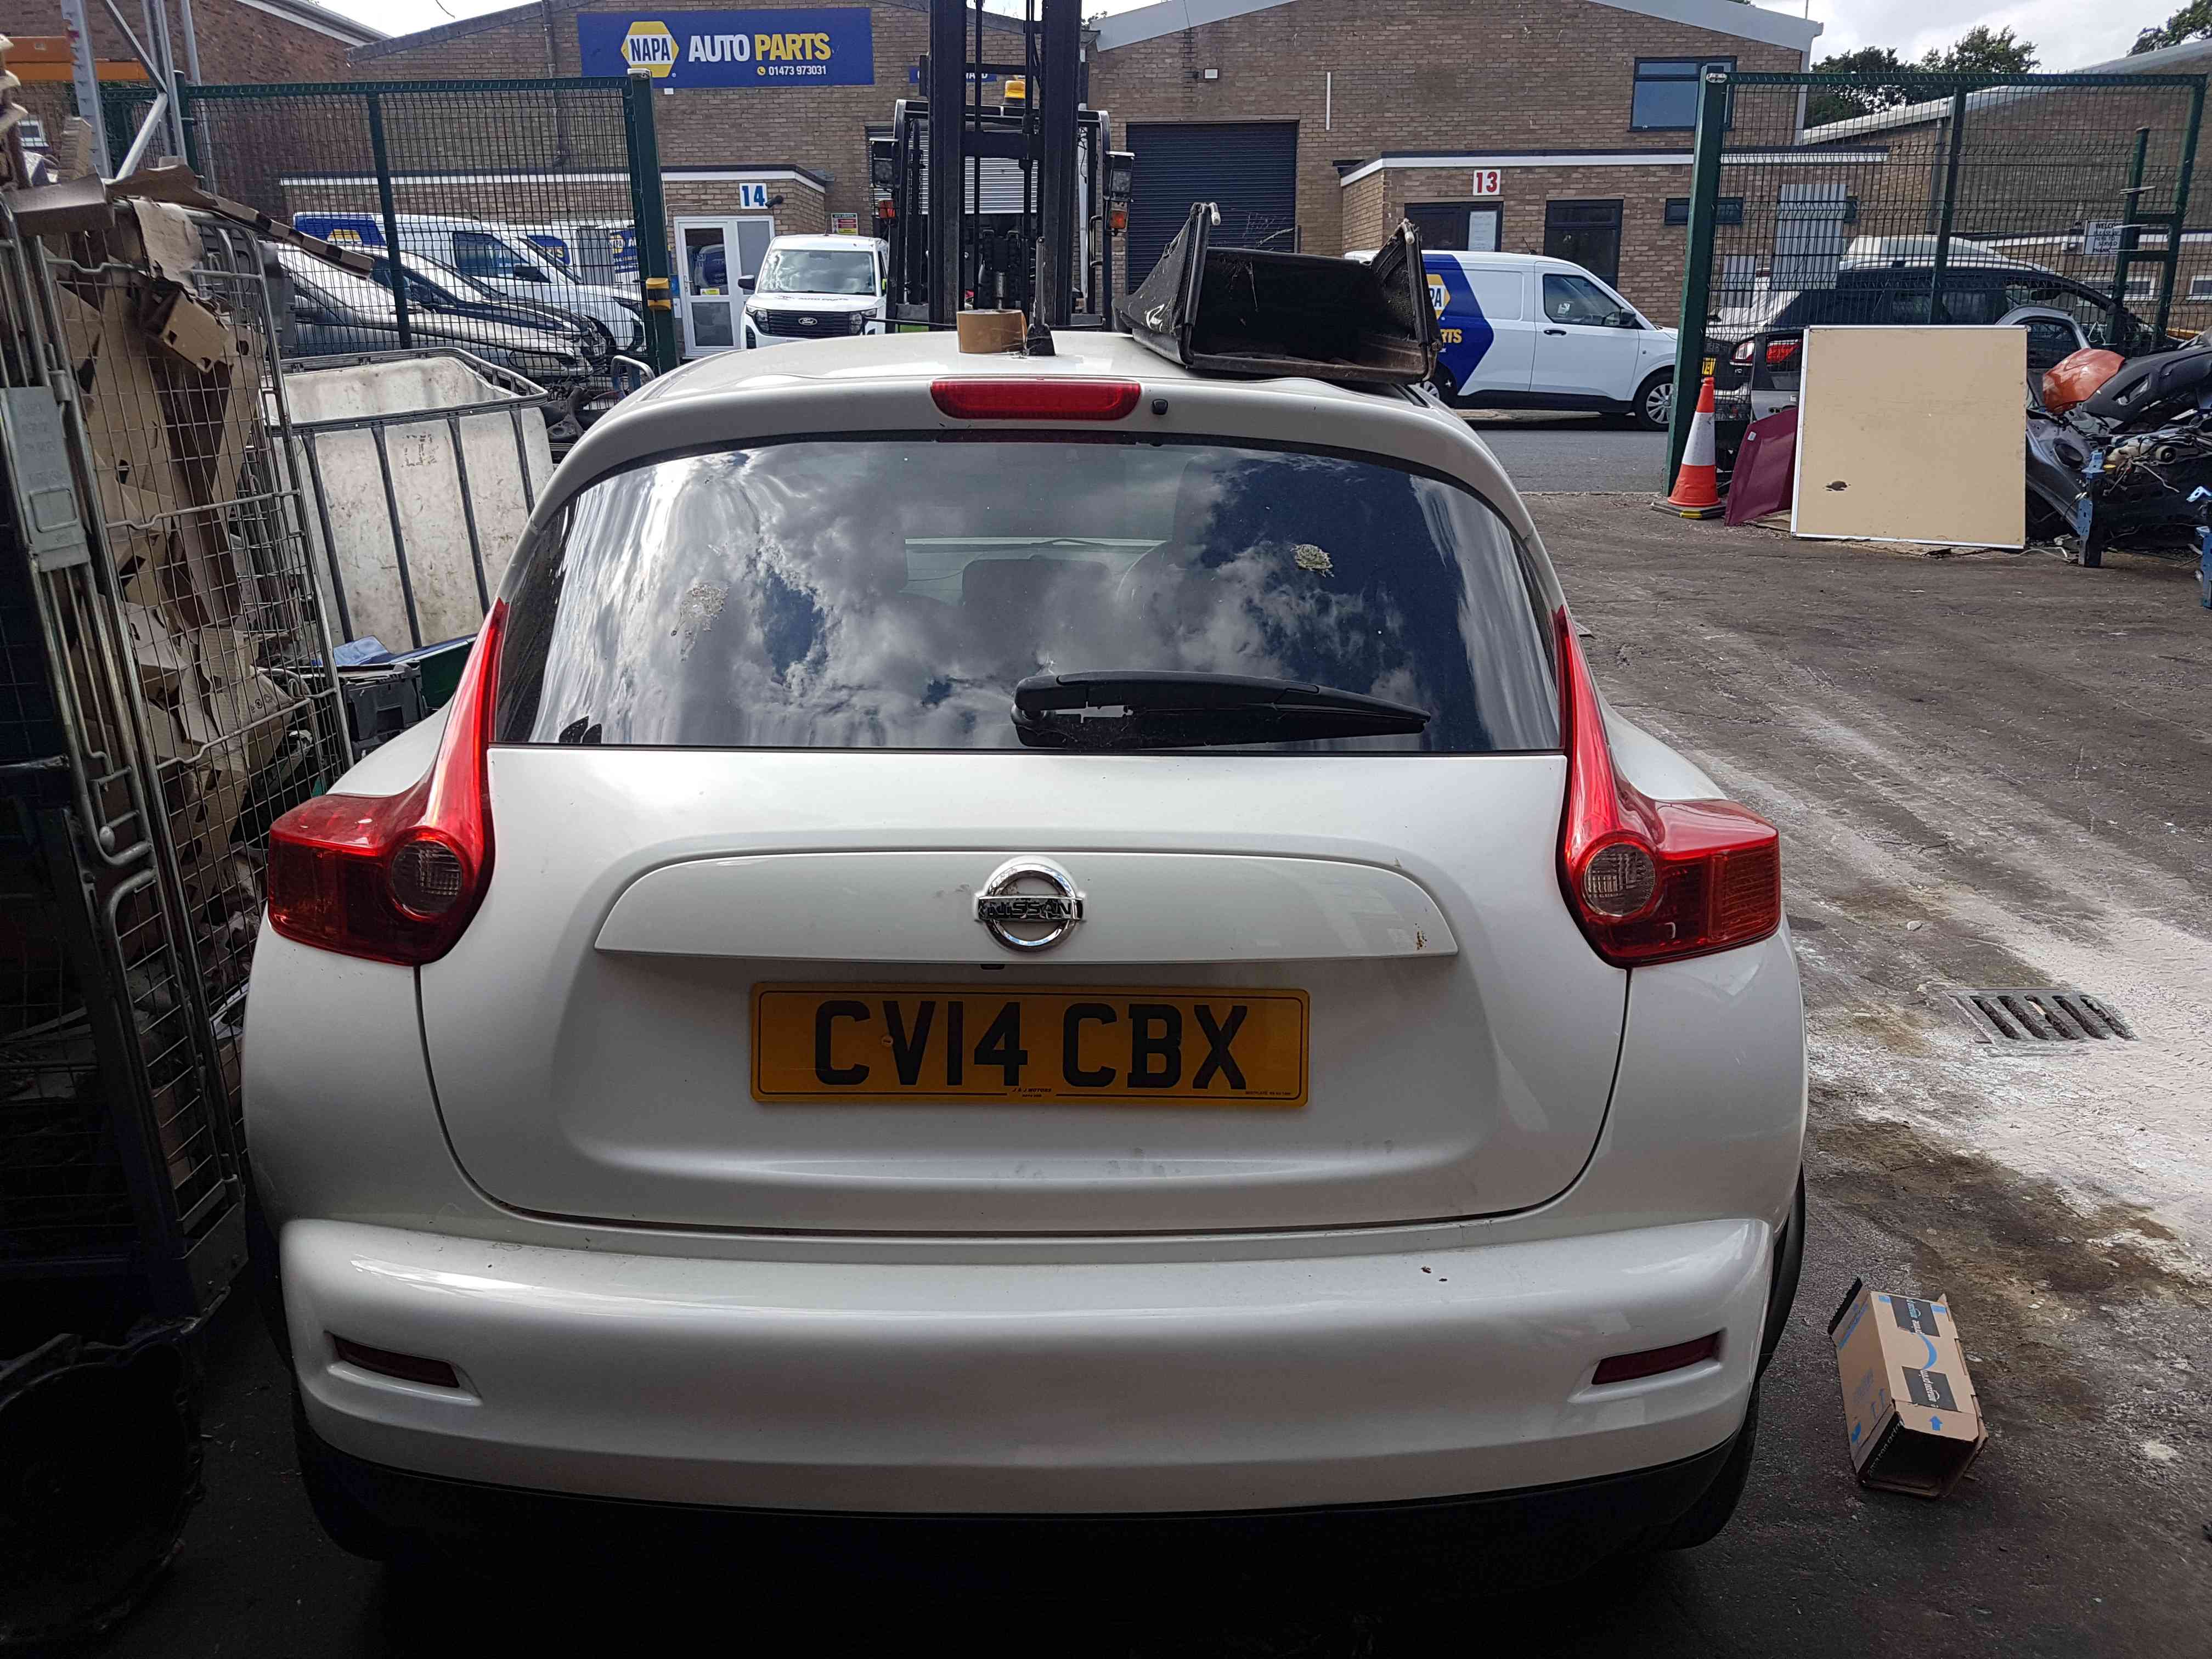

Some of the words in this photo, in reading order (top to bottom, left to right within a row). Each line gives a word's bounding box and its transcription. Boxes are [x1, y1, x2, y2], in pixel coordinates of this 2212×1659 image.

[630, 37, 671, 62] NAPA
[689, 34, 751, 62] AUTO
[754, 33, 832, 61] PARTS
[769, 66, 794, 76] 01473
[797, 65, 826, 75] 973031
[1476, 171, 1498, 193] 13
[742, 185, 765, 206] 14
[988, 901, 1072, 918] NISSAN
[815, 1000, 1028, 1087] CV14
[1062, 1002, 1248, 1090] CBX
